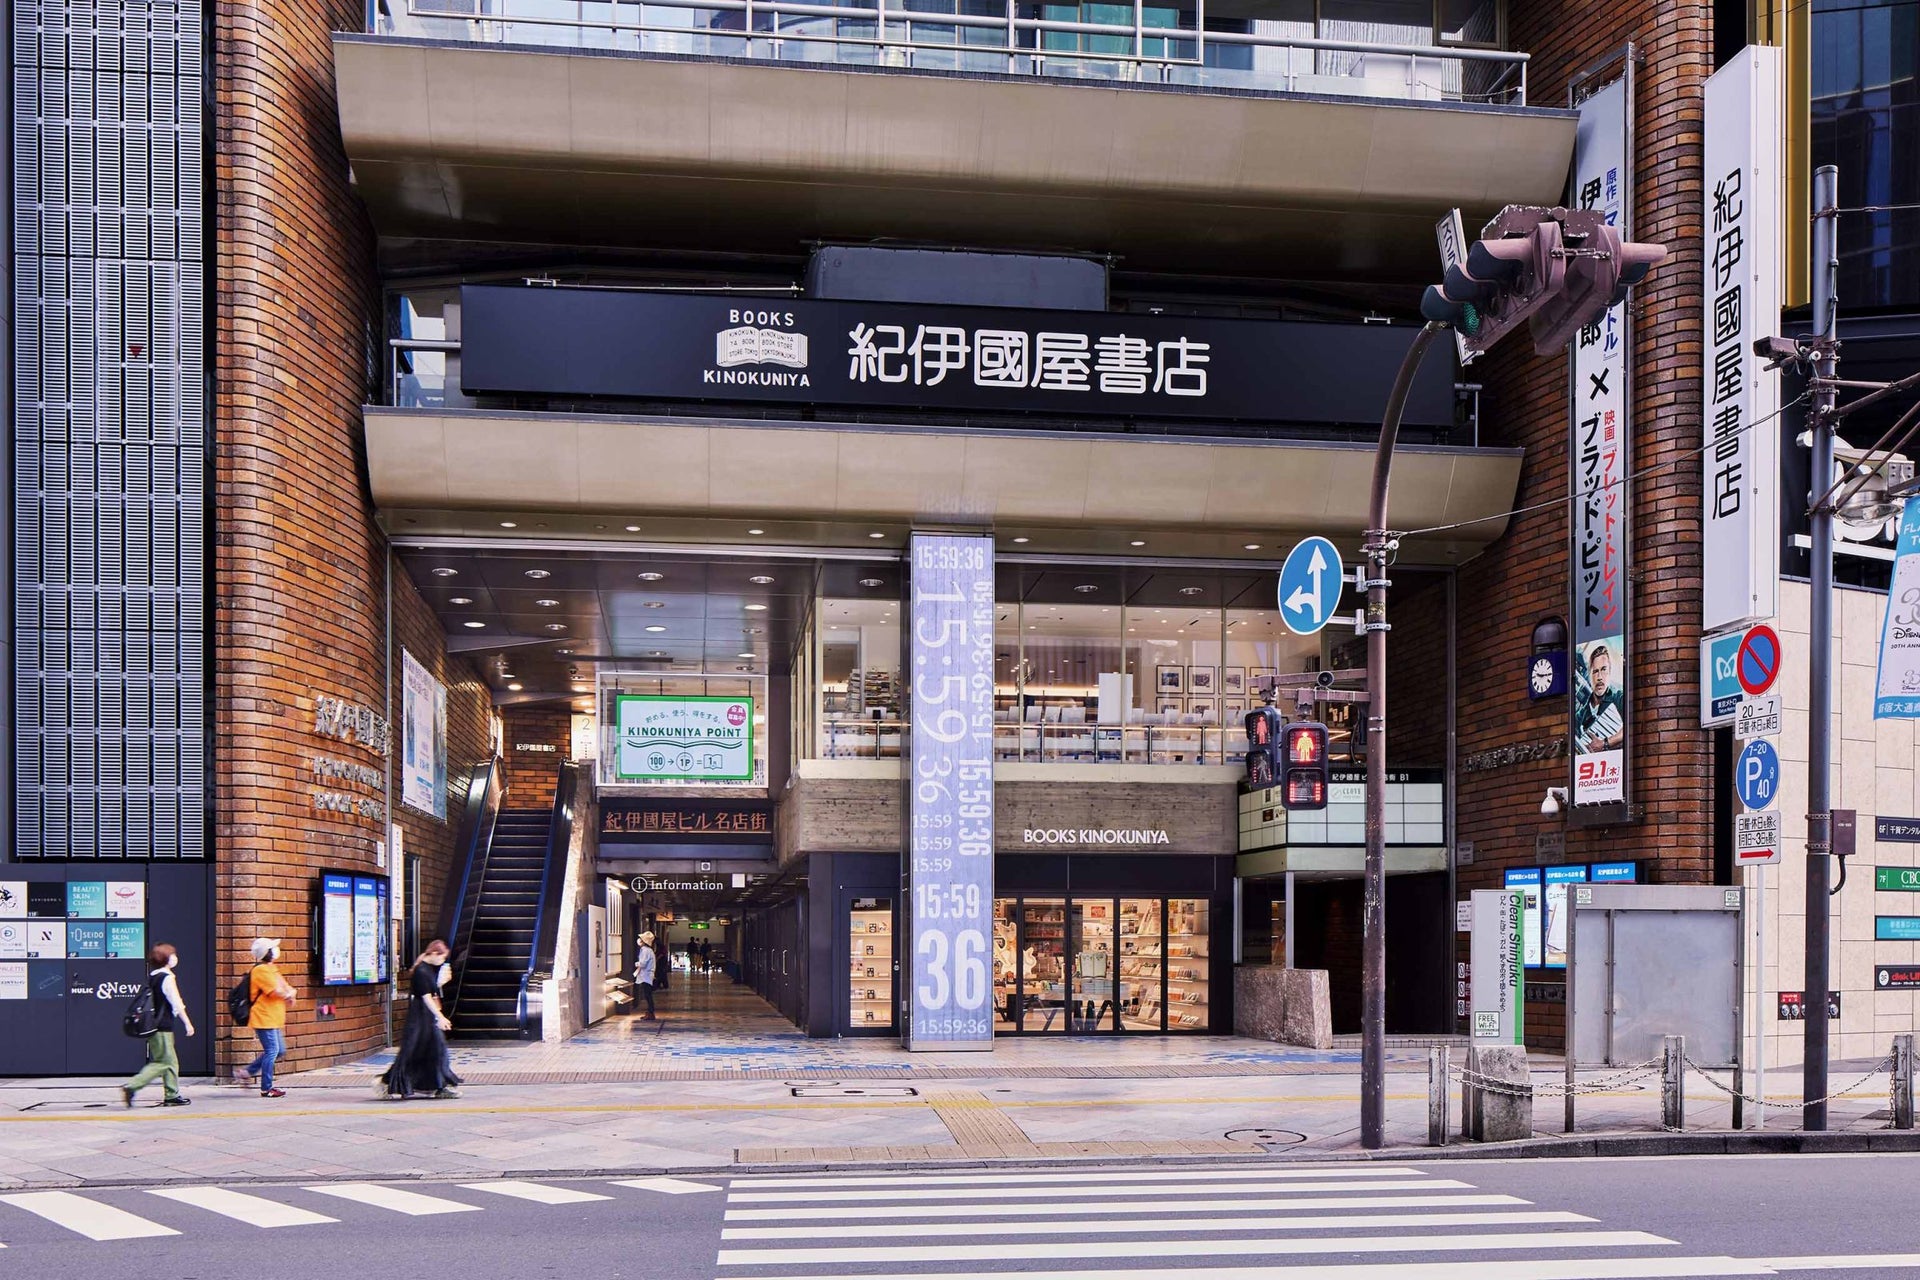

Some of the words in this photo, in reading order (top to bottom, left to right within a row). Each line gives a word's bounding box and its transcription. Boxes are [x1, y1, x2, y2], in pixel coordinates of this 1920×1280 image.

[729, 309, 794, 327] BOOKS
[1712, 168, 1744, 520] 紀伊國屋書店
[848, 322, 1210, 397] 紀伊國屋書店
[703, 370, 810, 387] KINOKUNIYA
[917, 546, 984, 569] 15:59:36
[1743, 705, 1754, 719] 20
[1768, 701, 1774, 714] 7
[582, 717, 590, 731] 2
[628, 727, 701, 737] KINOKUNIYA
[1749, 742, 1767, 756] 7-20
[650, 756, 663, 766] 100
[1578, 777, 1620, 788] ROADSHOW
[1746, 757, 1762, 801] P
[1757, 779, 1770, 798] 40
[958, 756, 991, 856] 15:59:36
[606, 811, 767, 831] 紀伊國屋ビル名店街
[913, 814, 951, 828] 15:59
[913, 837, 951, 850] 15:59
[1024, 829, 1076, 843] BOOKS
[1079, 829, 1169, 844] KINOKUNIYA
[913, 859, 951, 872] 15:59
[651, 879, 724, 891] Information
[917, 883, 980, 919] 15:59
[1509, 894, 1521, 930] Clean
[1507, 933, 1521, 987] Shinjuku
[918, 929, 986, 1010] 36
[1477, 1014, 1495, 1022] FREE
[919, 1019, 987, 1035] 15:59:36
